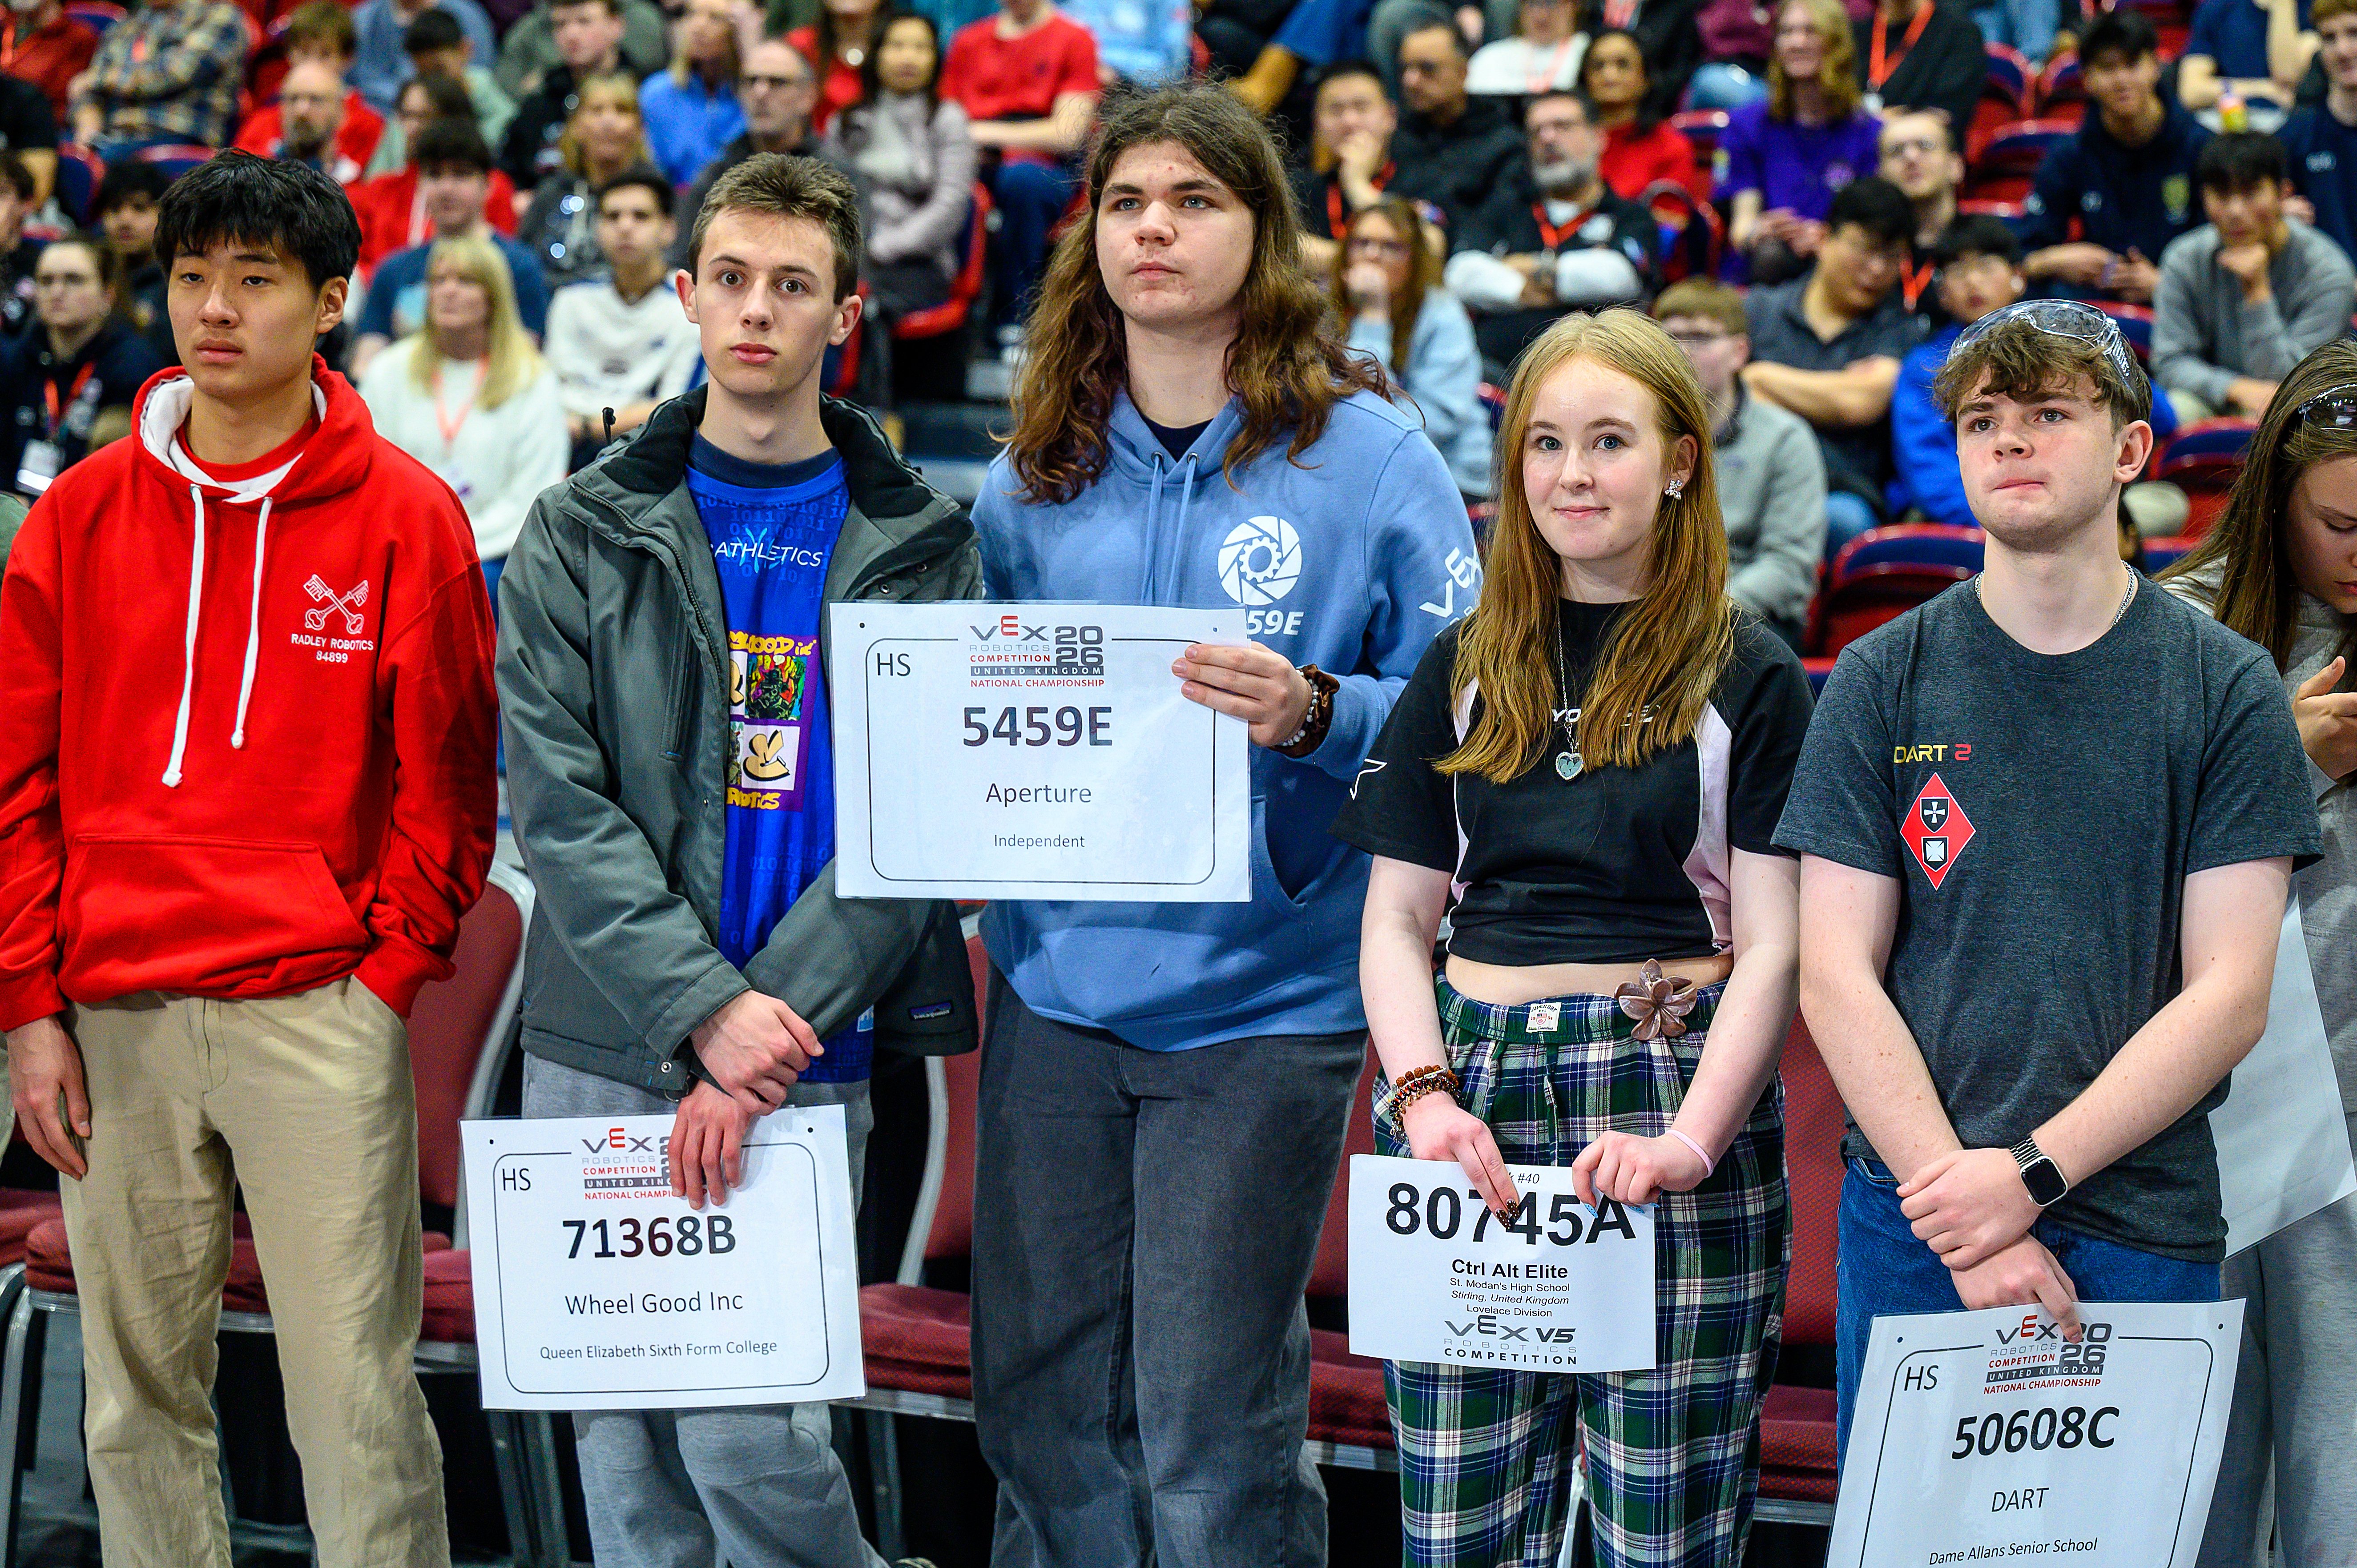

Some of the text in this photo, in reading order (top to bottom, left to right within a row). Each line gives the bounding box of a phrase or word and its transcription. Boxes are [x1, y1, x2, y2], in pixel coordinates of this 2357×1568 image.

[1419, 545, 1483, 618] VEX
[970, 615, 1048, 641] VEX
[1247, 610, 1304, 635] 59E
[291, 633, 374, 651] RADLEY ROBOTICS
[1055, 626, 1103, 645] 20
[316, 650, 348, 663] 84899
[877, 653, 911, 676] HS
[1056, 647, 1103, 666] 26
[963, 706, 1112, 747] 5459E
[1894, 744, 1971, 763] DART 2
[986, 783, 1092, 807] Aperture
[995, 834, 1085, 849] Independent
[581, 1128, 653, 1154] VEX
[582, 1156, 655, 1164] ROBOTICS
[502, 1168, 531, 1191] HS
[583, 1166, 656, 1175] COMPETITION
[1518, 1173, 1540, 1184] #40
[585, 1192, 631, 1200] NATIONAL
[1386, 1183, 1636, 1246] 80745A
[563, 1215, 736, 1259] 71368B
[1452, 1259, 1568, 1279] Ctrl Alt Elite
[1450, 1278, 1570, 1293] St. Modan's High School
[565, 1291, 743, 1314] Wheel Good Inc
[1451, 1291, 1569, 1306] Stirling, United Kingdom
[1467, 1304, 1552, 1317] Lovelace Division
[1444, 1315, 1576, 1343] VEX V5
[1996, 1315, 2059, 1345] VEX
[540, 1339, 778, 1359] Queen Elizabeth Sixth Form College
[1444, 1339, 1576, 1353] ROBOTICS
[1990, 1343, 2057, 1356] ROBOTICS
[2060, 1344, 2107, 1365] 26
[1444, 1348, 1577, 1365] COMPETITION
[1989, 1354, 2055, 1368] COMPETITION
[1904, 1365, 1938, 1391] HS
[1990, 1366, 2099, 1381] UNITED KINGDOM
[1983, 1379, 2101, 1394] NATIONAL CHAMPIONSHIP
[1952, 1407, 2119, 1459] 50608C
[1991, 1488, 2049, 1512] DART
[1930, 1538, 2098, 1565] Dame Allans Senior School
